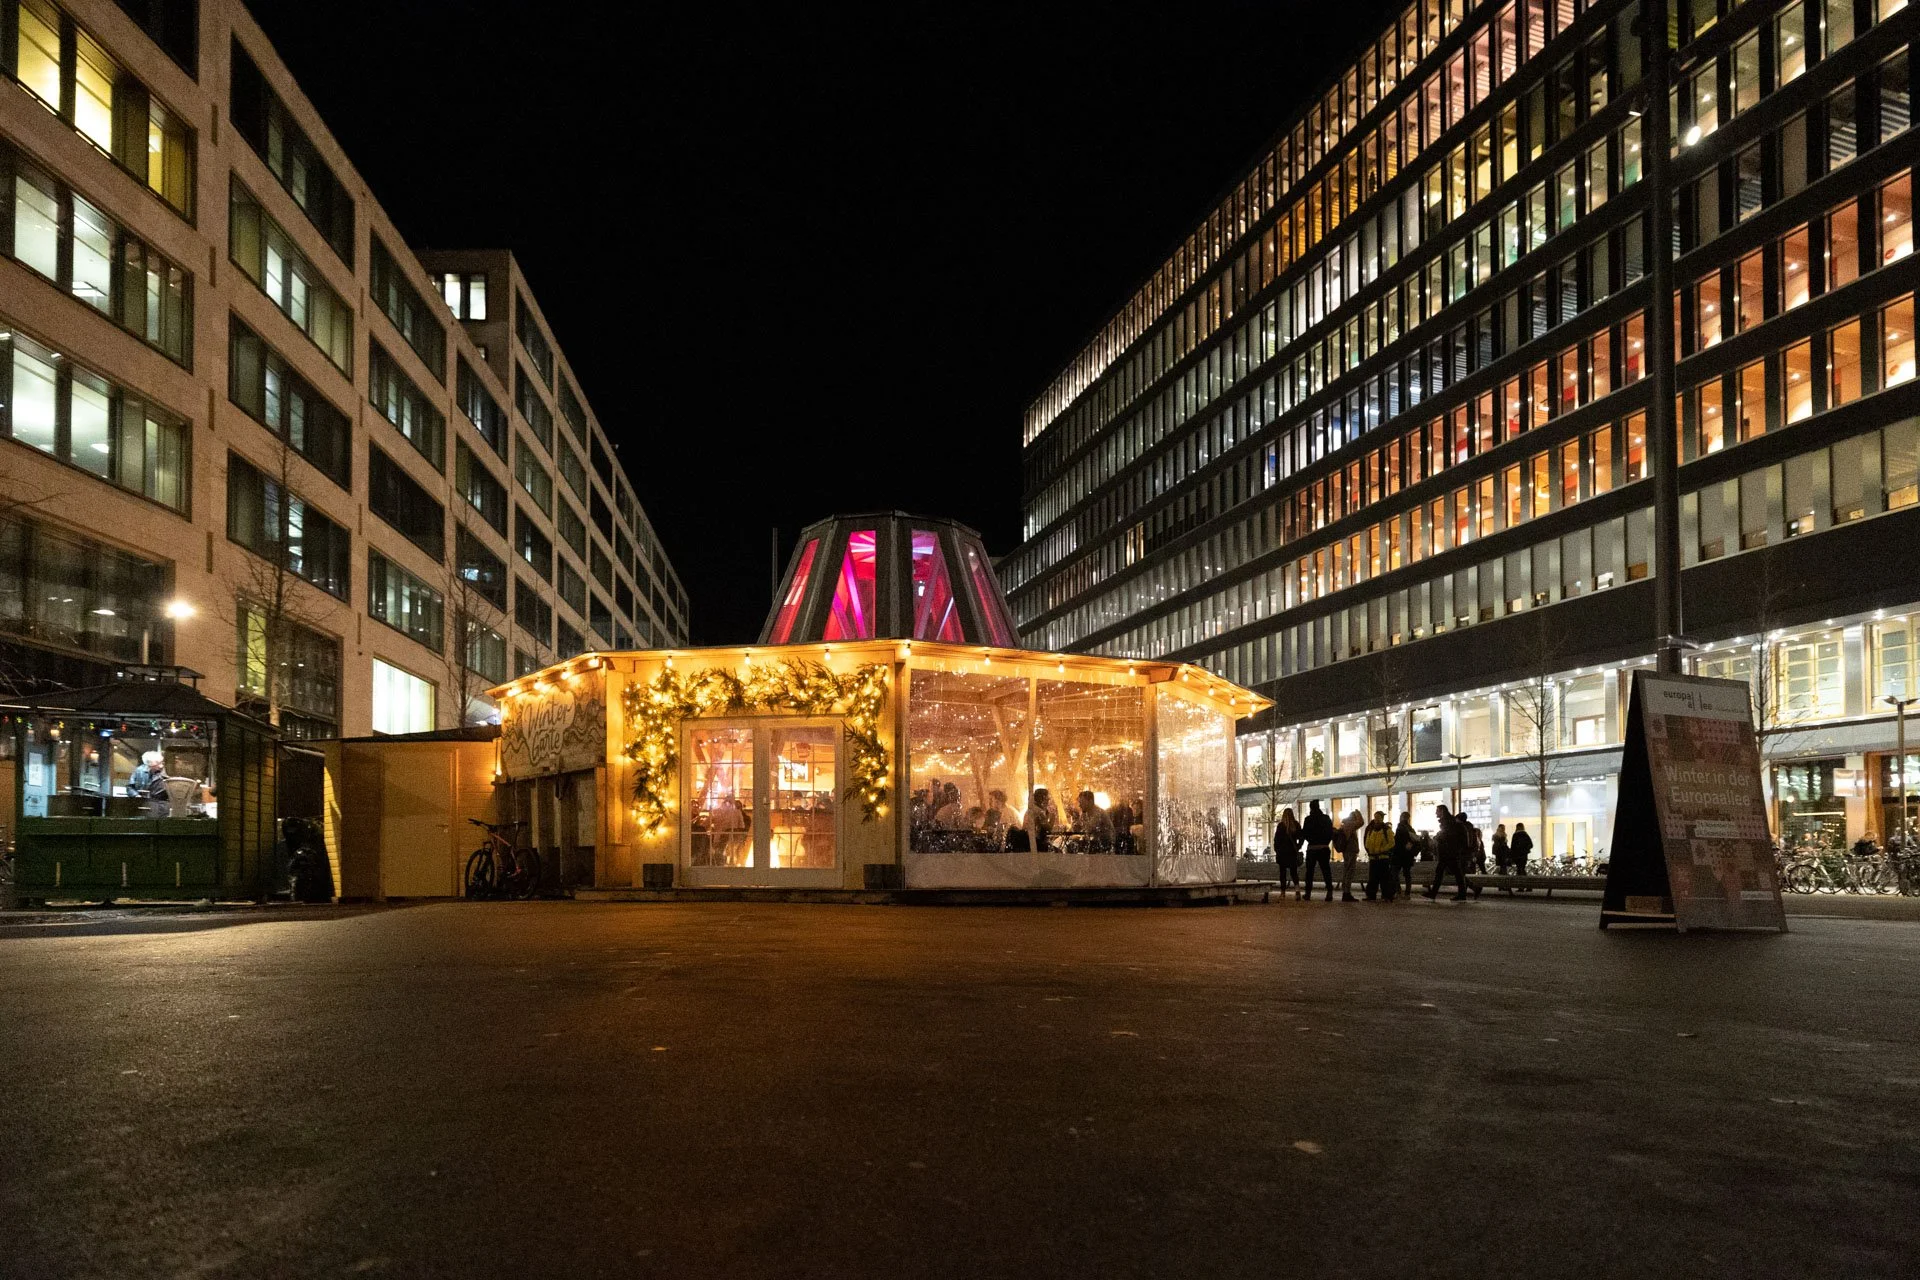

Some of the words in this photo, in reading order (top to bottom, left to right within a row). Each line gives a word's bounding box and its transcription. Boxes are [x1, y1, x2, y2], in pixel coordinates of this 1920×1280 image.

[525, 694, 573, 738] Winter
[1664, 764, 1710, 784] Winter
[1712, 768, 1726, 786] in
[1728, 769, 1750, 787] der
[1670, 786, 1751, 808] Europaallee
